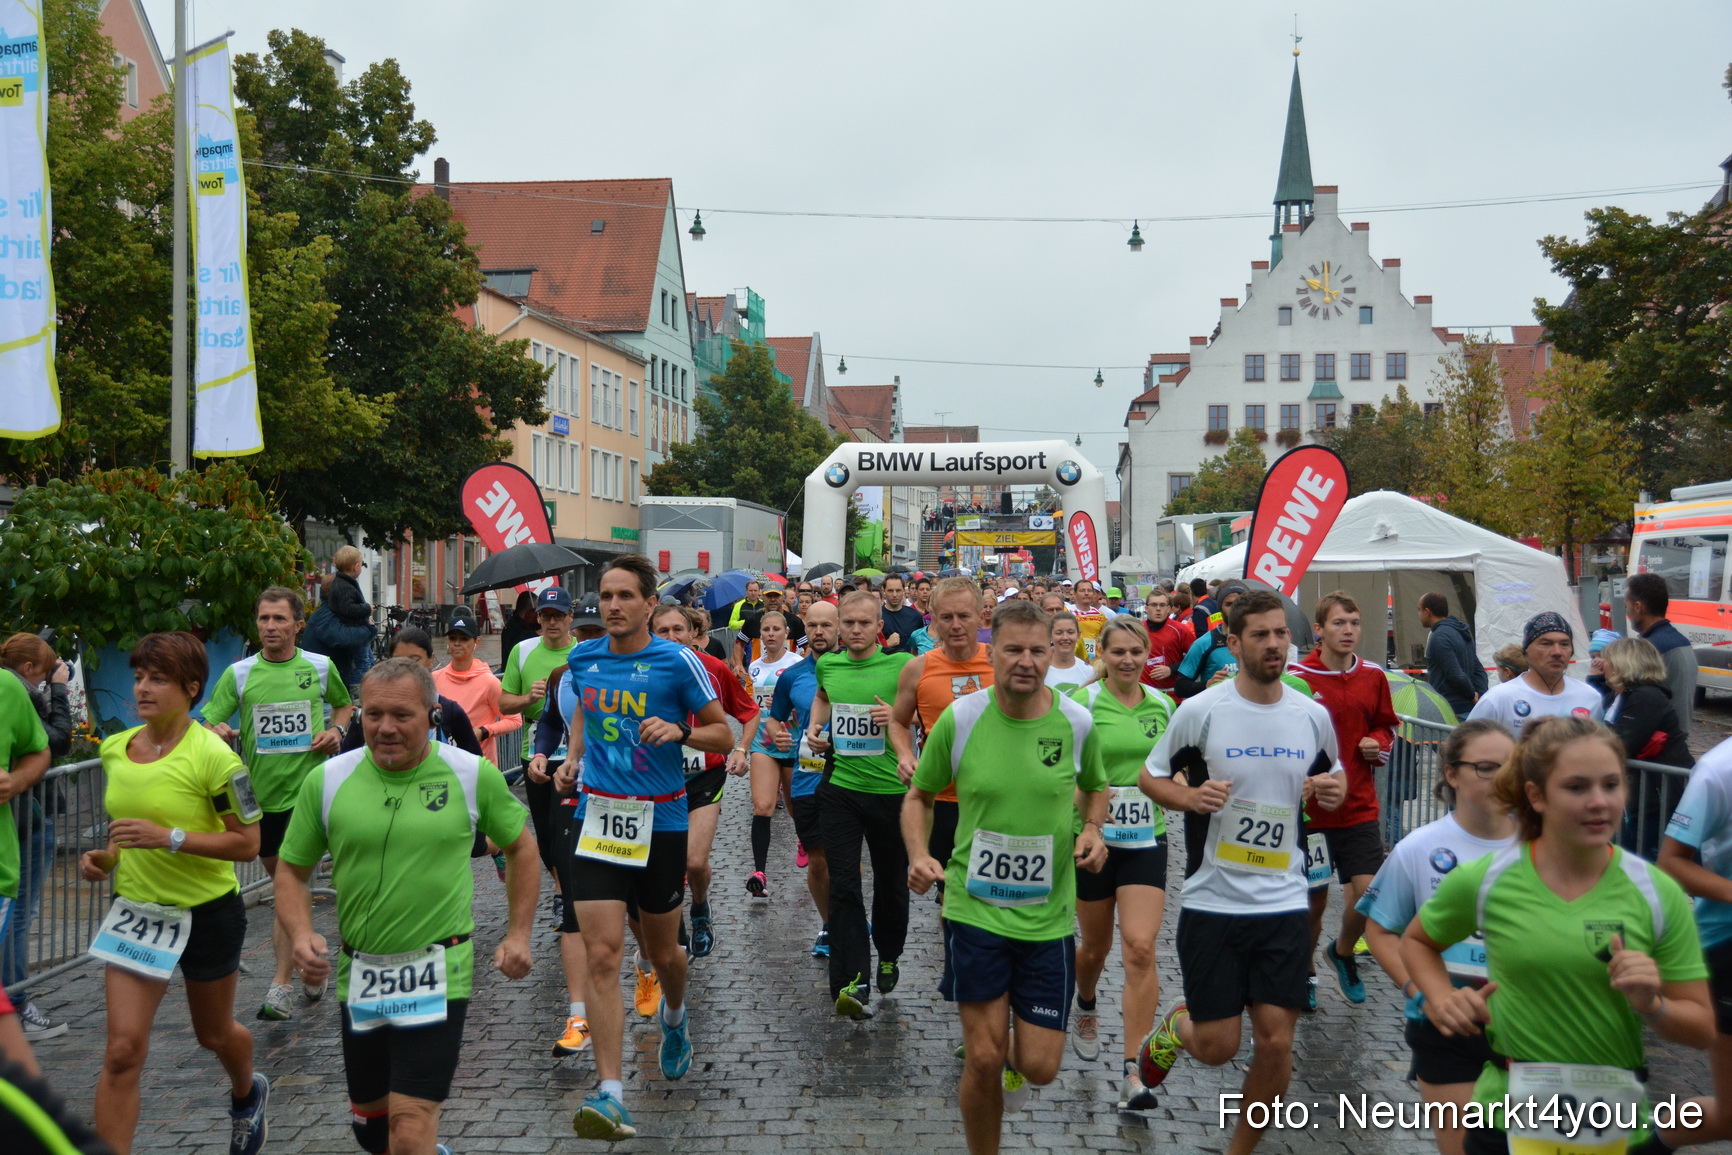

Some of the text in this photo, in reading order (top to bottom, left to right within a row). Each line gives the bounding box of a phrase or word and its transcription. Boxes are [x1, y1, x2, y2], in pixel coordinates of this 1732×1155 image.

[858, 451, 1046, 474] BMW Laufsport
[995, 534, 1018, 543] ZIEL
[1254, 465, 1335, 592] REWE
[583, 687, 647, 717] RUN
[260, 713, 307, 734] 2553
[837, 716, 880, 736] 2056
[270, 738, 299, 747] Herbert
[847, 740, 867, 749] Peter
[1226, 747, 1304, 759] DELPHI
[600, 813, 638, 840] 165
[1115, 831, 1138, 840] Heike
[1236, 817, 1284, 848] 229
[596, 842, 632, 856] Andreas
[1246, 851, 1265, 864] Tim
[977, 850, 1046, 881] 2632
[990, 885, 1027, 898] Rainer
[112, 908, 180, 948] 2411
[116, 942, 157, 964] Brigitte
[360, 961, 438, 998] 2504
[376, 1001, 418, 1016] Hubert
[1032, 1006, 1059, 1017] JAKO
